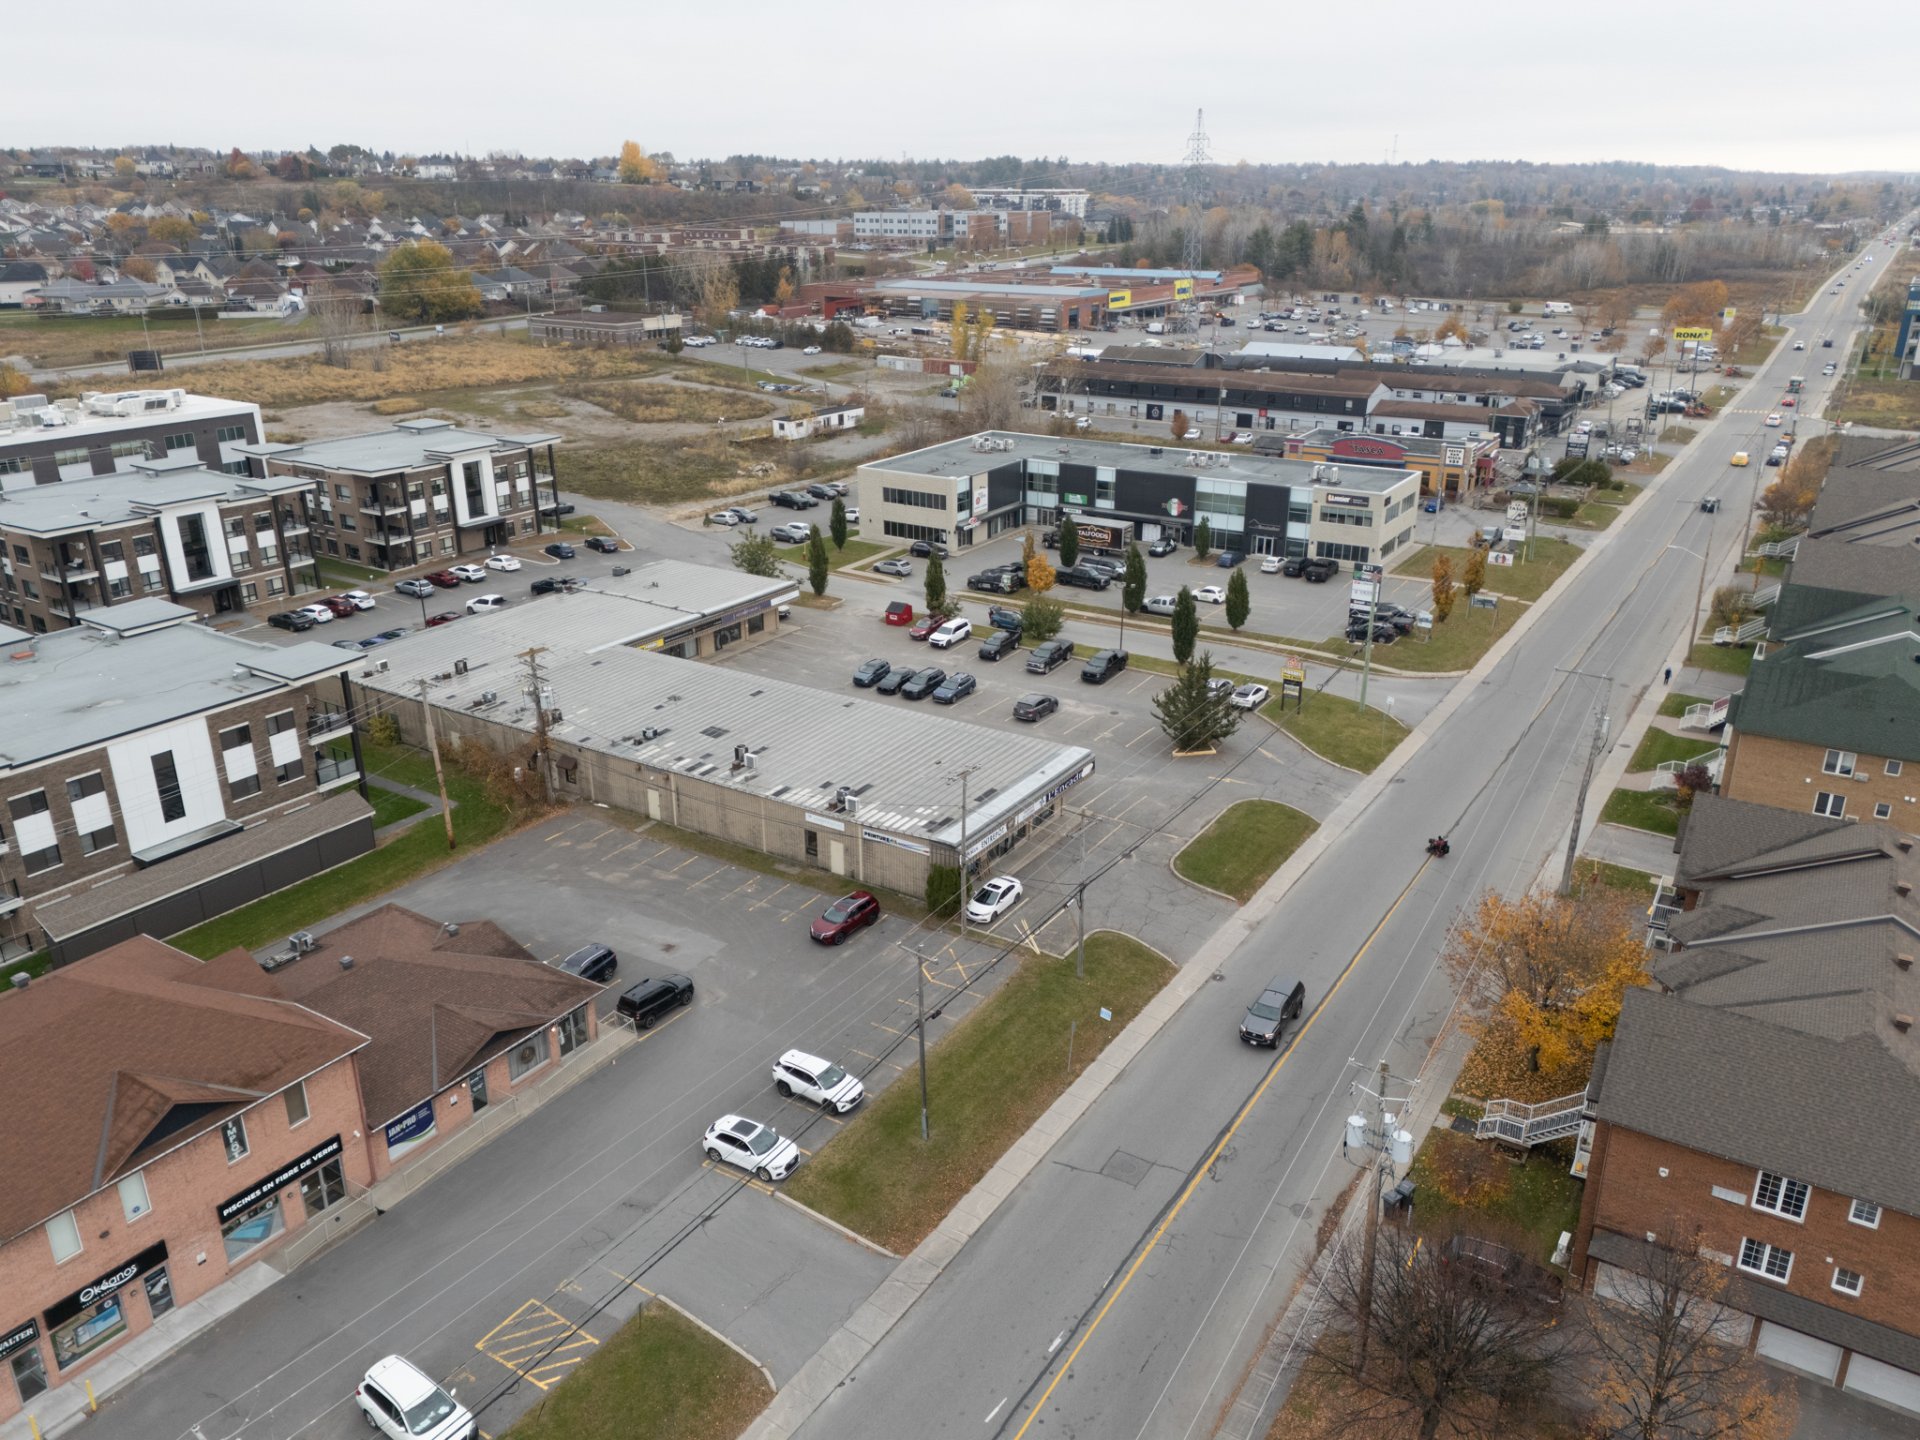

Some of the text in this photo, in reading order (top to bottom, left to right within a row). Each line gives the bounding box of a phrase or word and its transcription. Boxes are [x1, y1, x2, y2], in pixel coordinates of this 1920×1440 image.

[223, 1141, 339, 1217] PISCINES EN FIBRE DE VERRE
[80, 1264, 138, 1303] Okéanos
